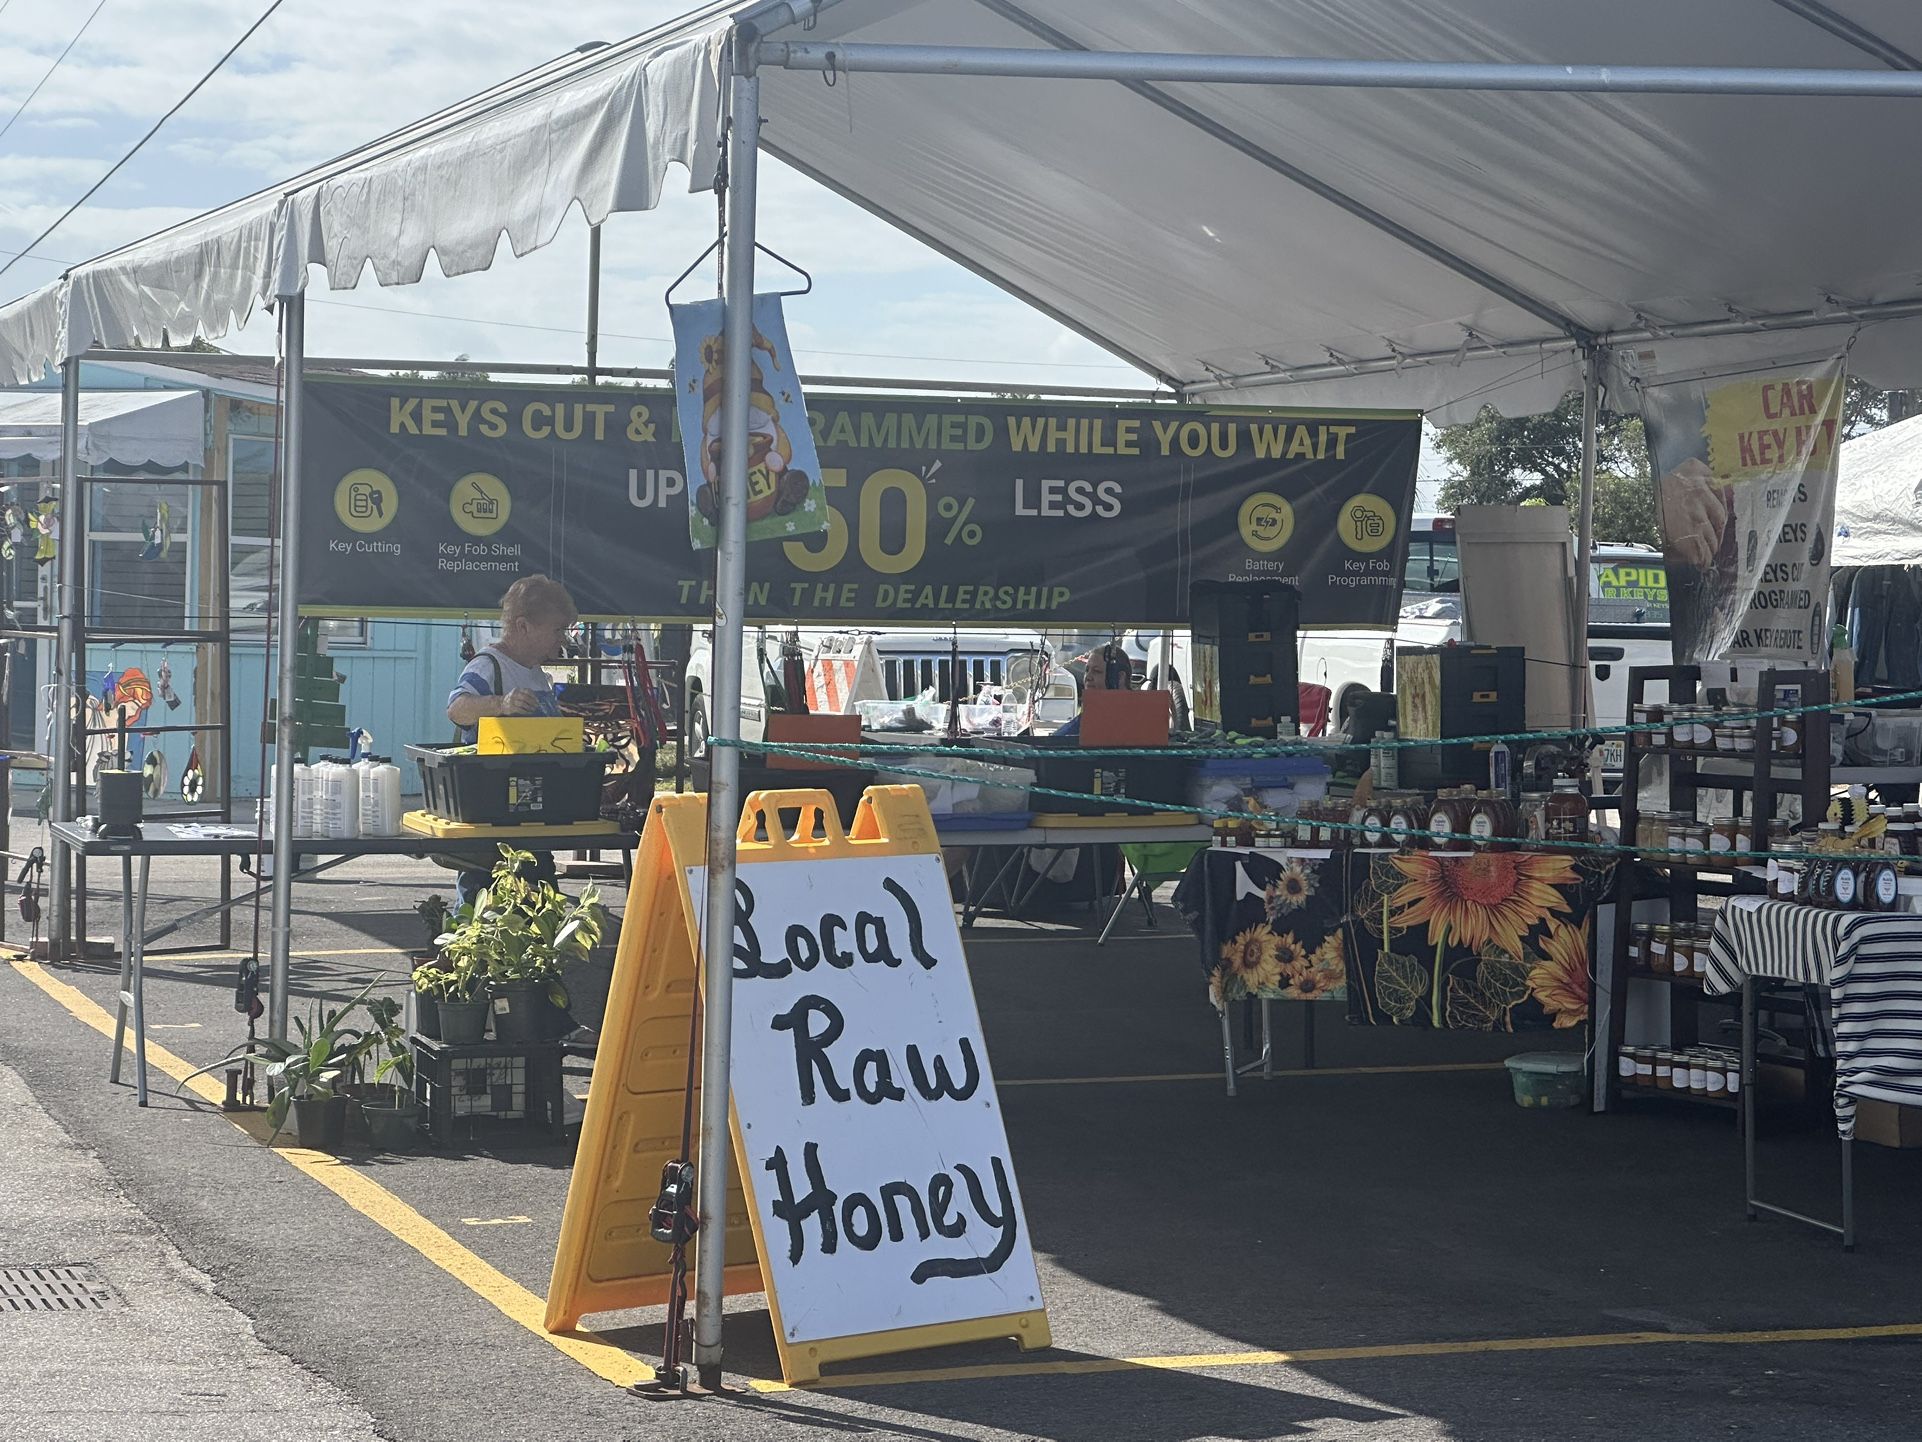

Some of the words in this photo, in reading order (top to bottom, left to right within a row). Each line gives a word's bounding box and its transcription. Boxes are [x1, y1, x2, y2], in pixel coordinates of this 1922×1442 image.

[1762, 380, 1818, 420] CAR
[389, 396, 508, 438] KEYS
[521, 401, 615, 440] CUT
[626, 404, 656, 442] &
[1006, 415, 1141, 455] WHILE
[1151, 420, 1238, 457] YOU
[1249, 423, 1356, 460] WAIT
[1738, 427, 1787, 467] KEY
[628, 467, 684, 508] UP
[1014, 478, 1123, 519] LESS
[329, 539, 353, 556] Key
[355, 540, 401, 557] Cutting
[438, 543, 462, 558] Key
[465, 544, 488, 556] Fob
[491, 544, 522, 558] Shell
[438, 558, 520, 574] Replacement
[1245, 559, 1285, 575] Battery
[1344, 560, 1366, 575] Key
[1369, 560, 1391, 571] Fob
[1600, 567, 1666, 588] APID
[678, 580, 770, 606] THN
[790, 582, 859, 608] THE
[875, 584, 1072, 610] DEALERSHIP
[1620, 588, 1668, 601] KEYS
[732, 876, 938, 980] Local
[771, 994, 980, 1107] Raw
[764, 1141, 1017, 1285] Honey
